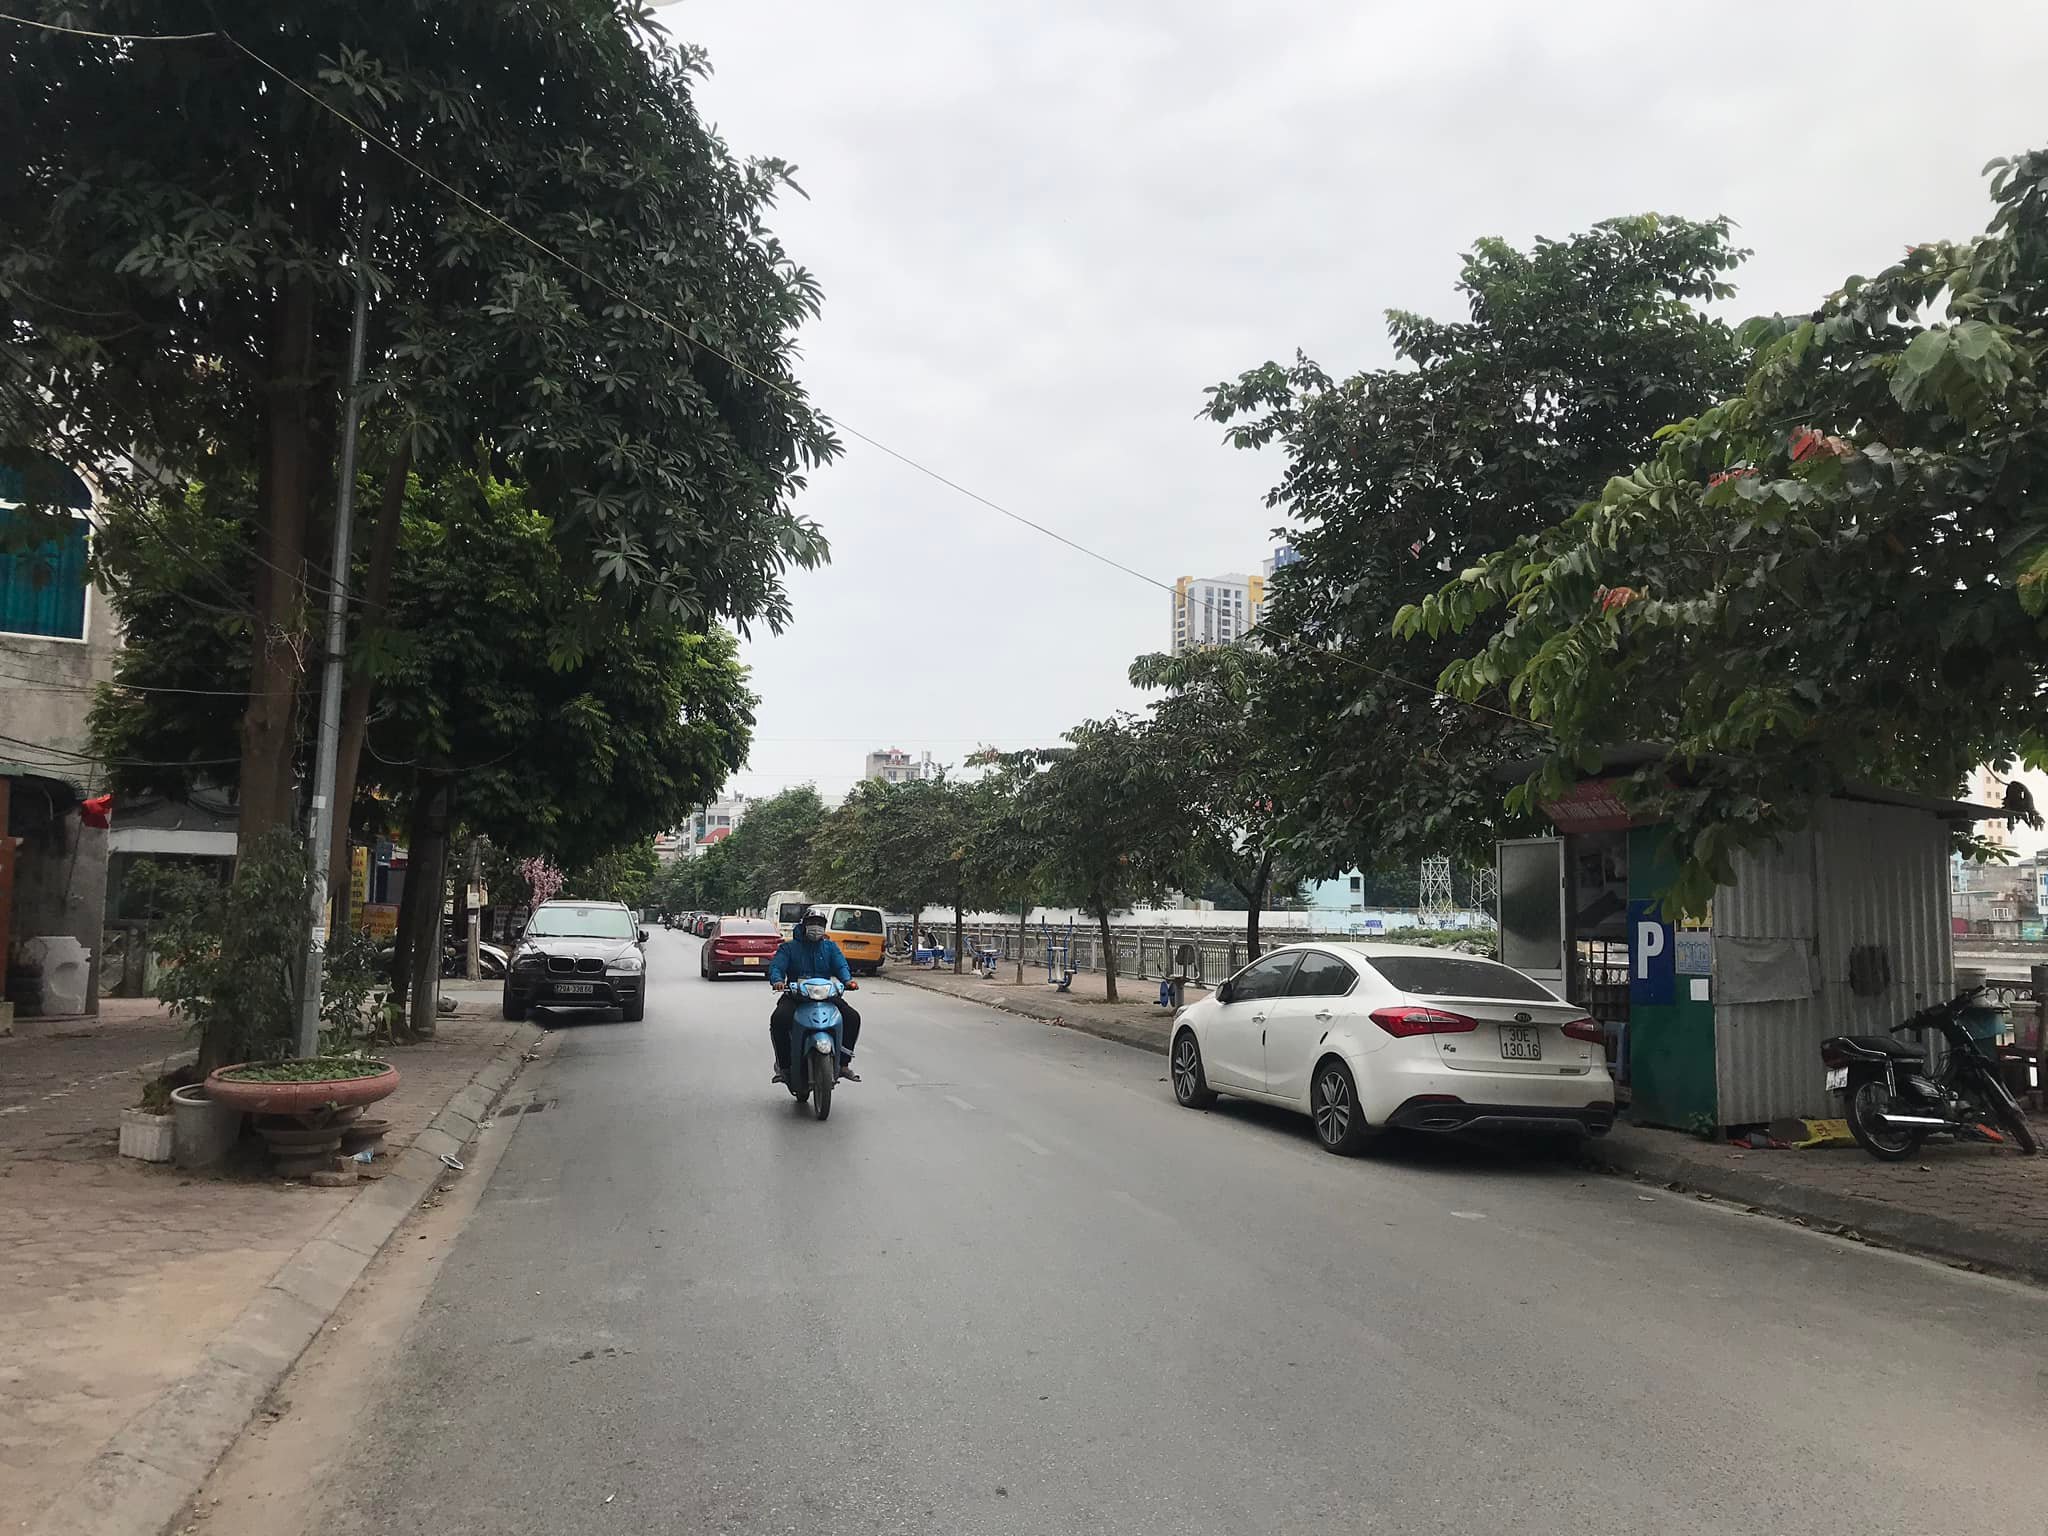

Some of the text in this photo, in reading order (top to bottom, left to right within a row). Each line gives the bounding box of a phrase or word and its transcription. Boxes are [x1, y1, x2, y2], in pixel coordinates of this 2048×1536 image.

[1637, 921, 1664, 978] P
[1509, 1028, 1530, 1042] 30E
[1503, 1043, 1539, 1057] 130.16
